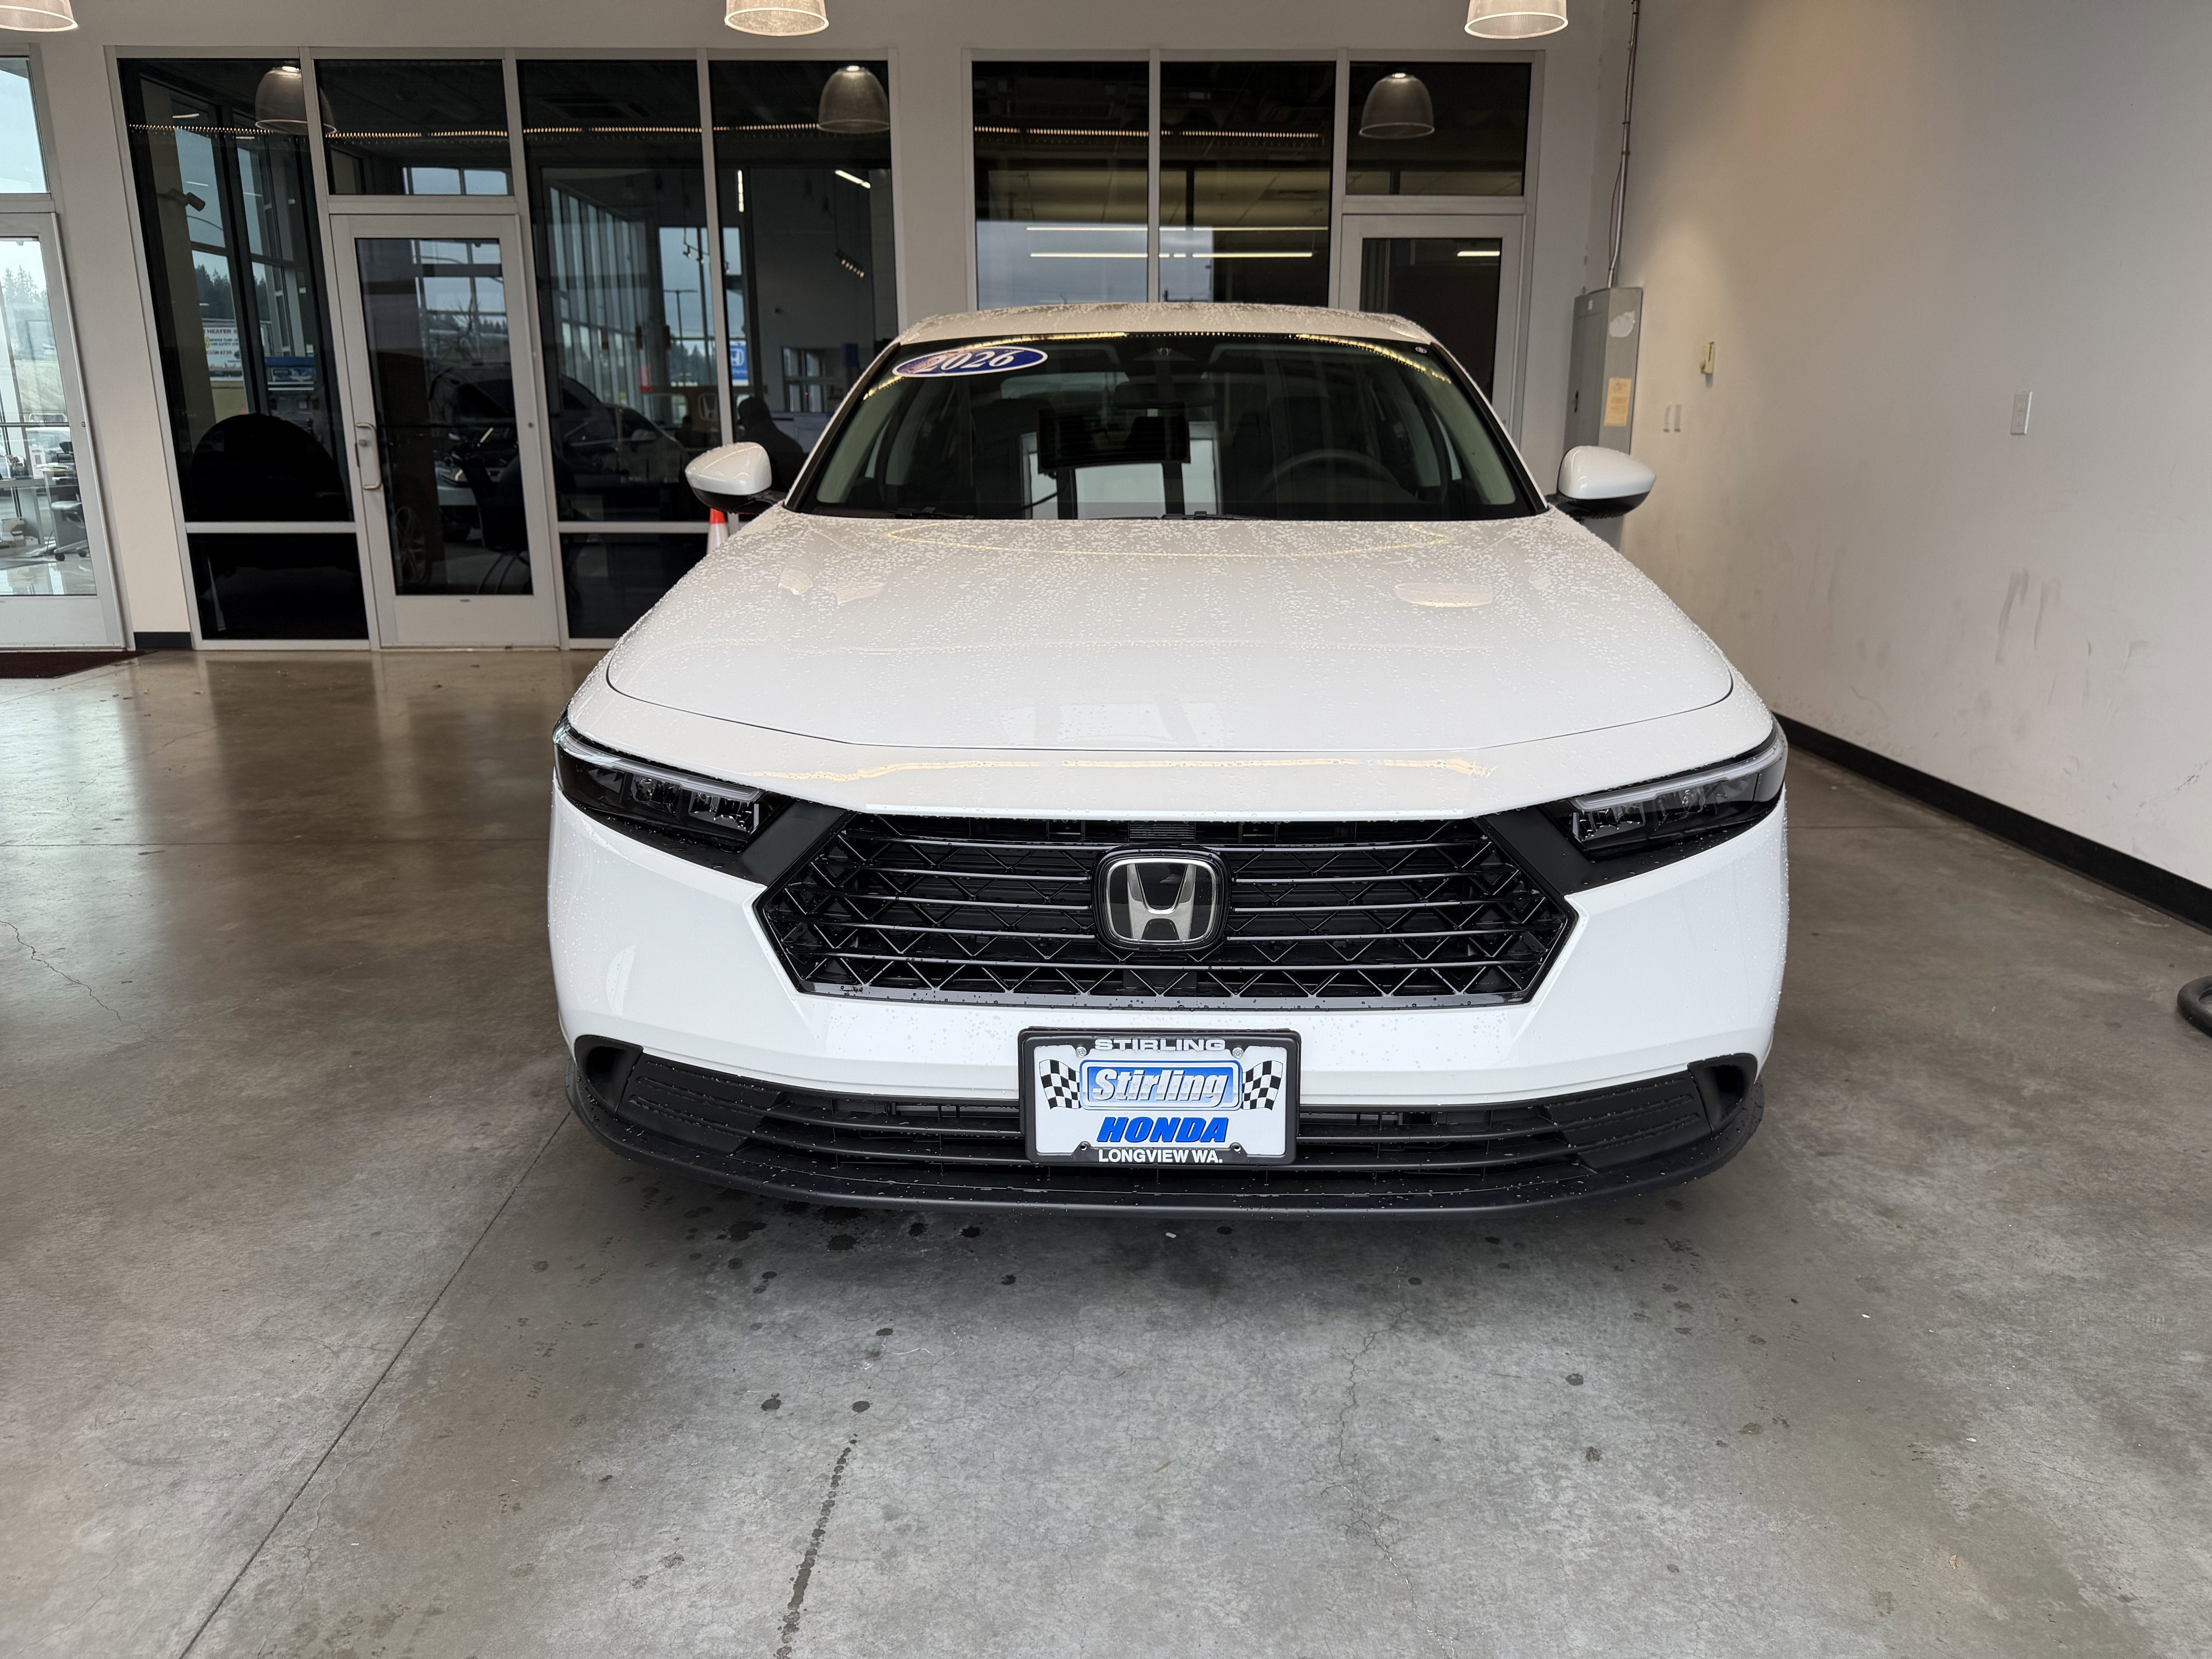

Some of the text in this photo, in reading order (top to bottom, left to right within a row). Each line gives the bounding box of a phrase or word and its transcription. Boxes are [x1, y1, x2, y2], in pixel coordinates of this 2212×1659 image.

[913, 350, 1024, 374] 2026
[1094, 1038, 1226, 1051] STIRLING
[1092, 1068, 1228, 1108] Stirling
[1096, 1117, 1229, 1142] HONDA
[1098, 1149, 1223, 1163] LONGVIEW WA.
